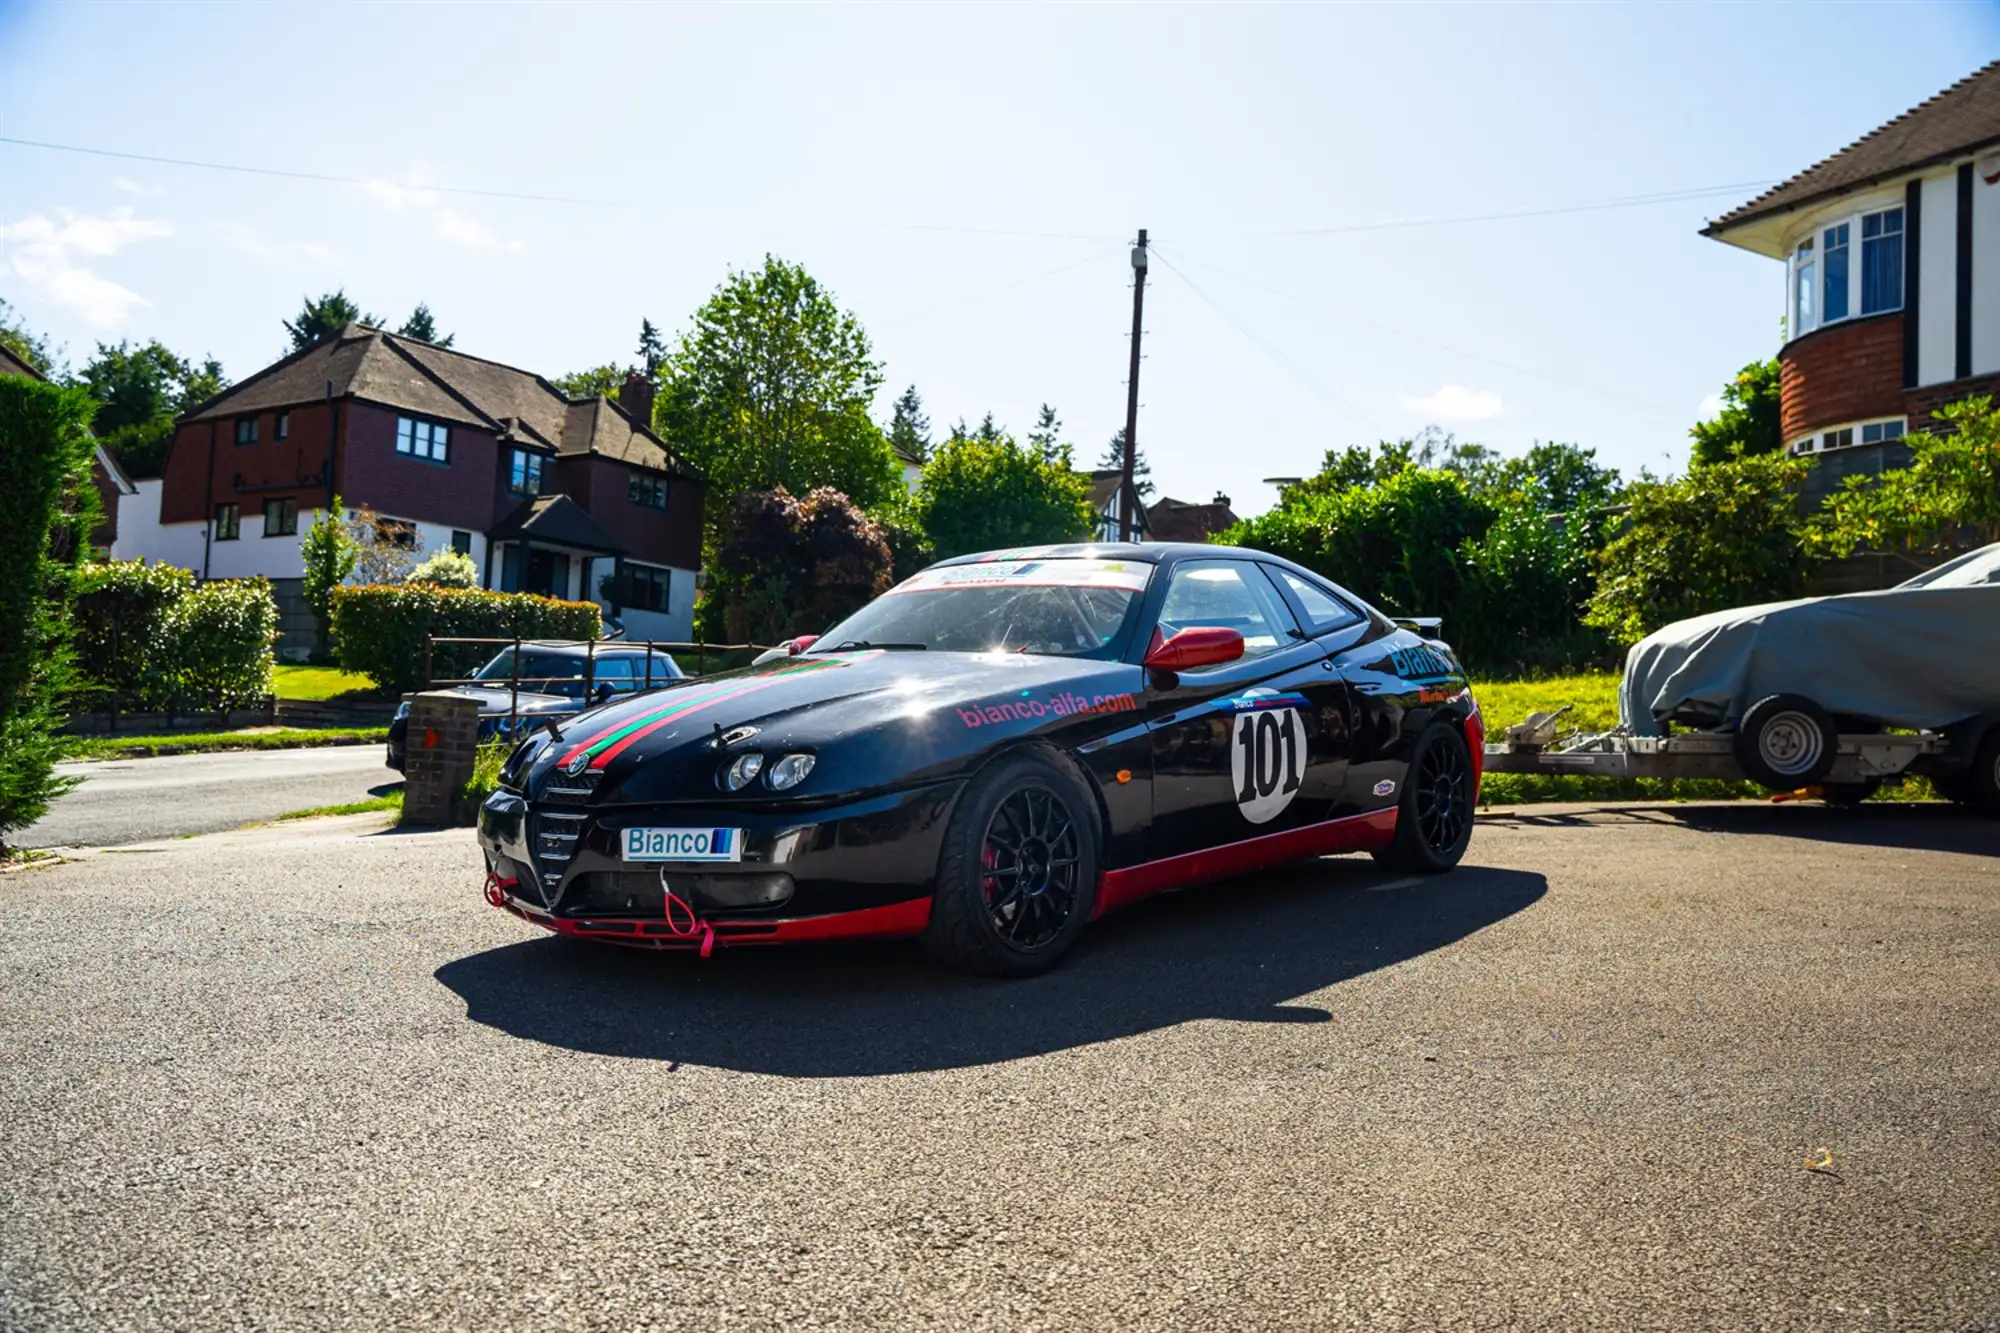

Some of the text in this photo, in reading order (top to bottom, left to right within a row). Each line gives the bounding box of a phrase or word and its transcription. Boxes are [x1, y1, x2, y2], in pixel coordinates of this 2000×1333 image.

[957, 691, 1136, 728] bianco-alfa.com
[1238, 709, 1300, 804] 101
[628, 828, 709, 854] Bianco
